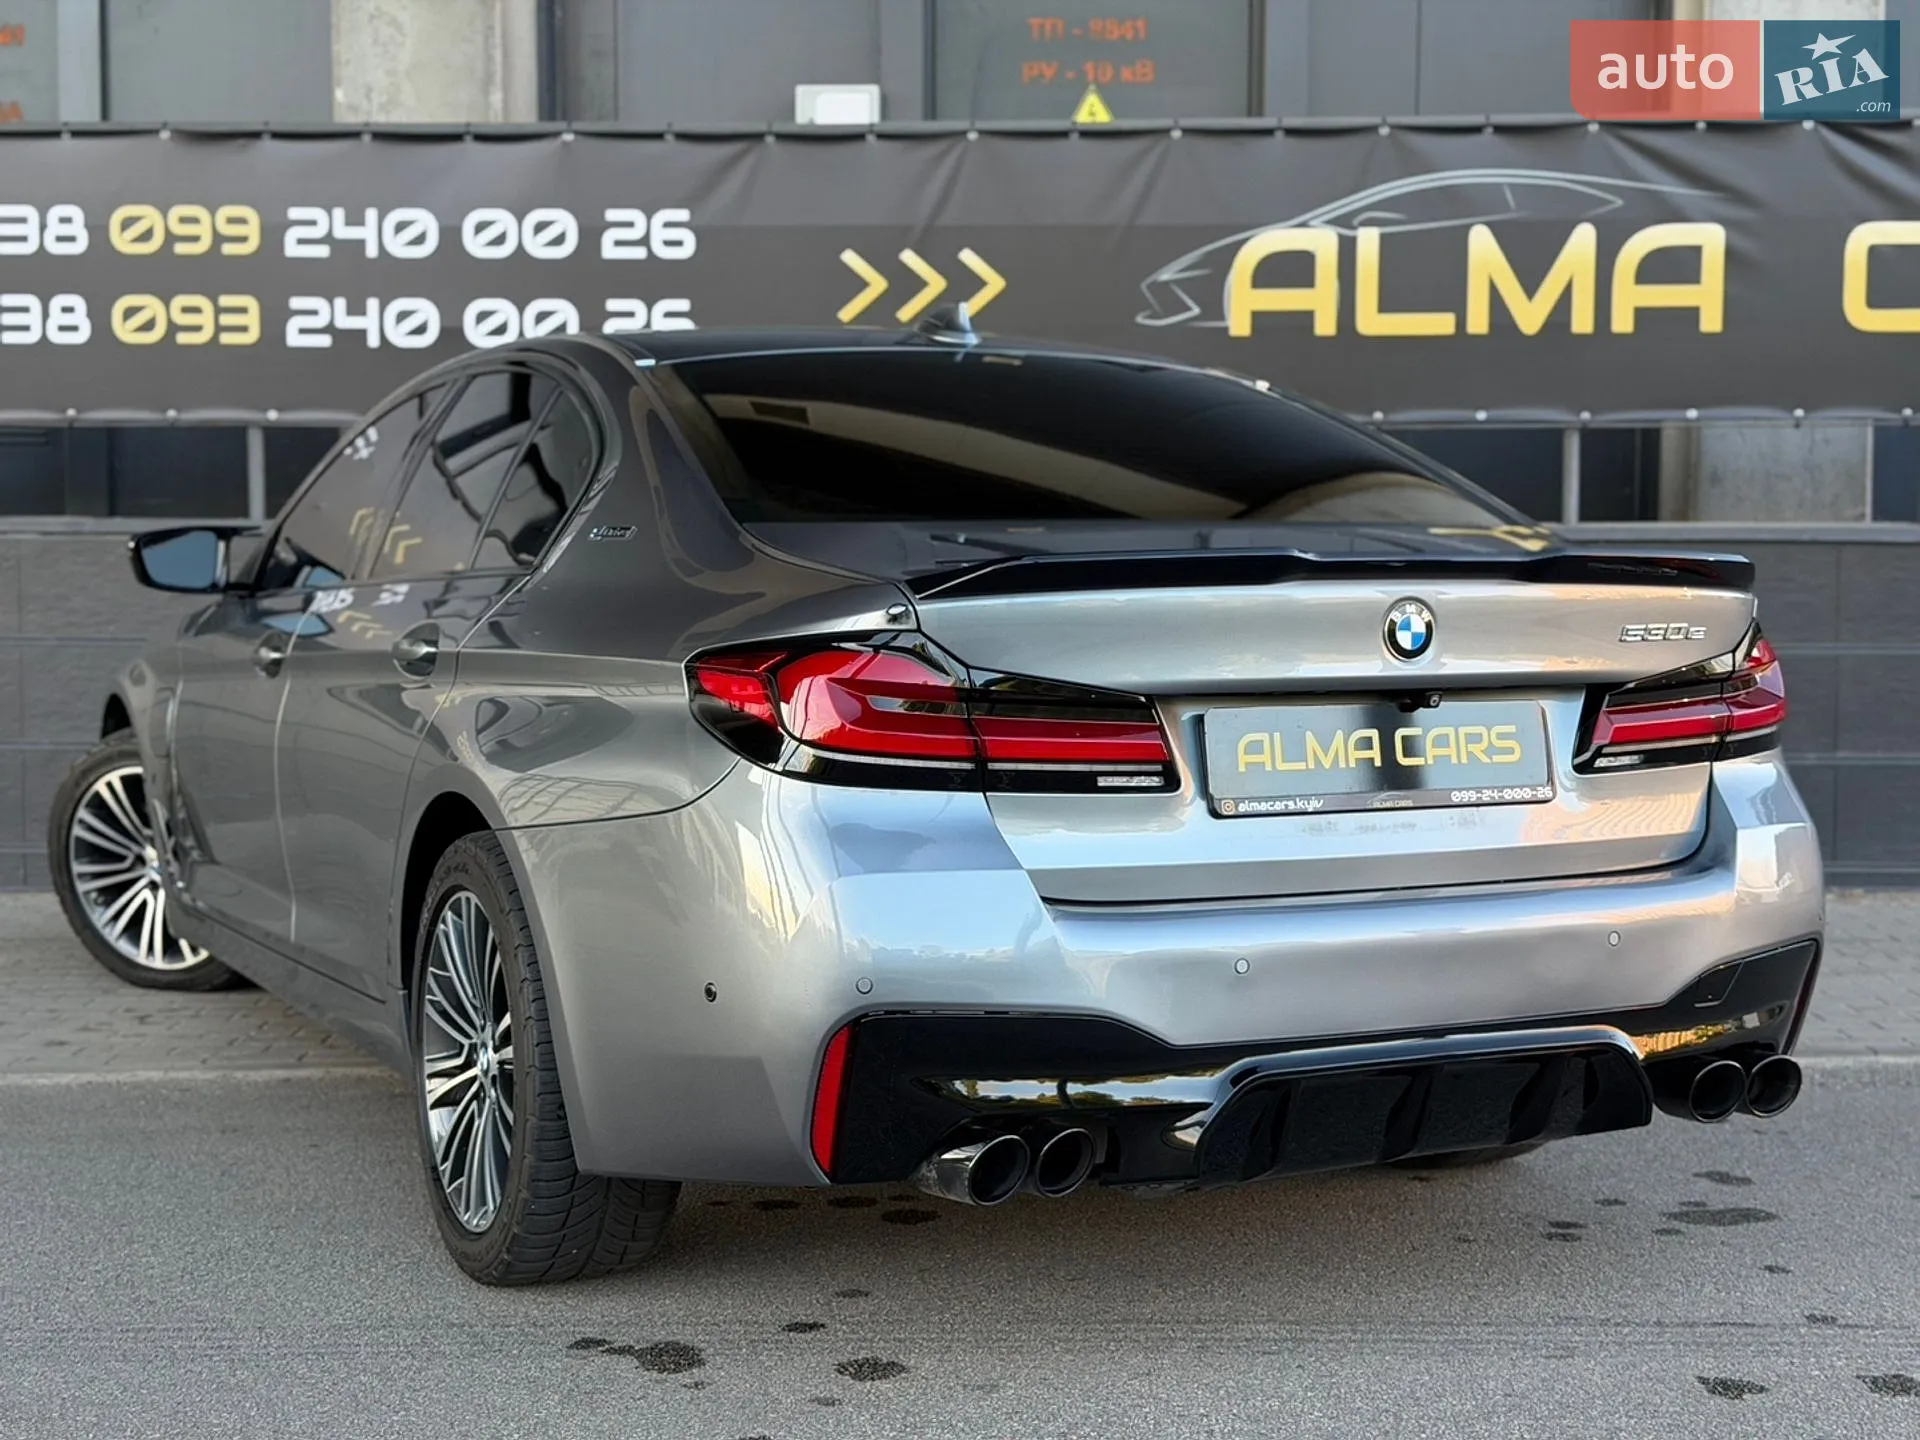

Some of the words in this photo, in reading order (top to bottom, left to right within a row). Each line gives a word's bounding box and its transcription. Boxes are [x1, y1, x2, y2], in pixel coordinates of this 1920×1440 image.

[1083, 60, 1115, 84] 10
[0, 203, 90, 256] 38
[109, 204, 262, 256] 099
[283, 206, 440, 259] 240
[461, 207, 580, 260] 00
[601, 208, 697, 260] 26
[1227, 221, 1727, 338] ALMA
[0, 293, 93, 345] 38
[111, 294, 262, 346] 093
[285, 296, 441, 349] 240
[462, 297, 580, 348] 00
[1390, 603, 1432, 623] BMW
[1236, 727, 1382, 773] ALMA
[1394, 724, 1522, 767] CARS
[1237, 796, 1325, 812] almacars.kyiv
